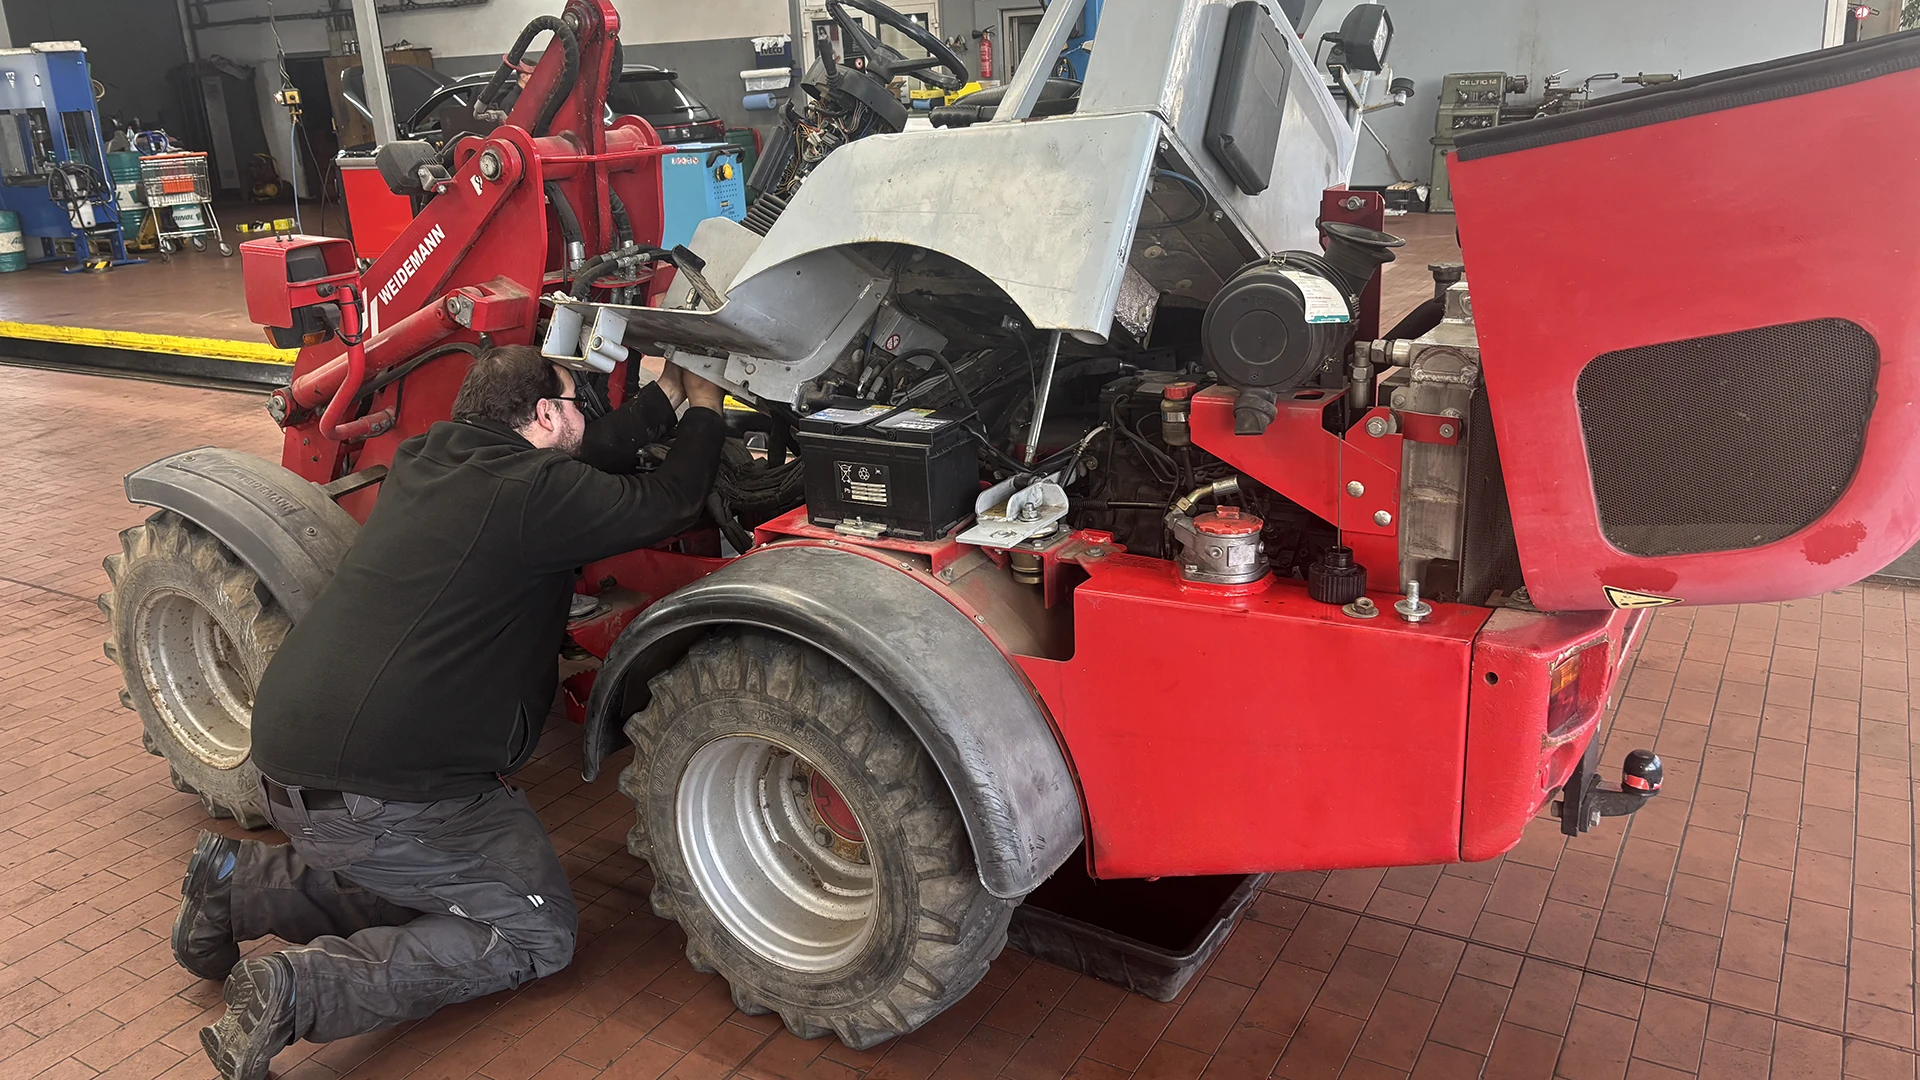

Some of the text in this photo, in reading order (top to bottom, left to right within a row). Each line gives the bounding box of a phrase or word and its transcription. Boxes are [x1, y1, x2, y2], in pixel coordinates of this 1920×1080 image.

[761, 46, 783, 54] IVECO
[378, 223, 446, 305] WEIDEMANN
[234, 469, 297, 512] WEIDEMANN
